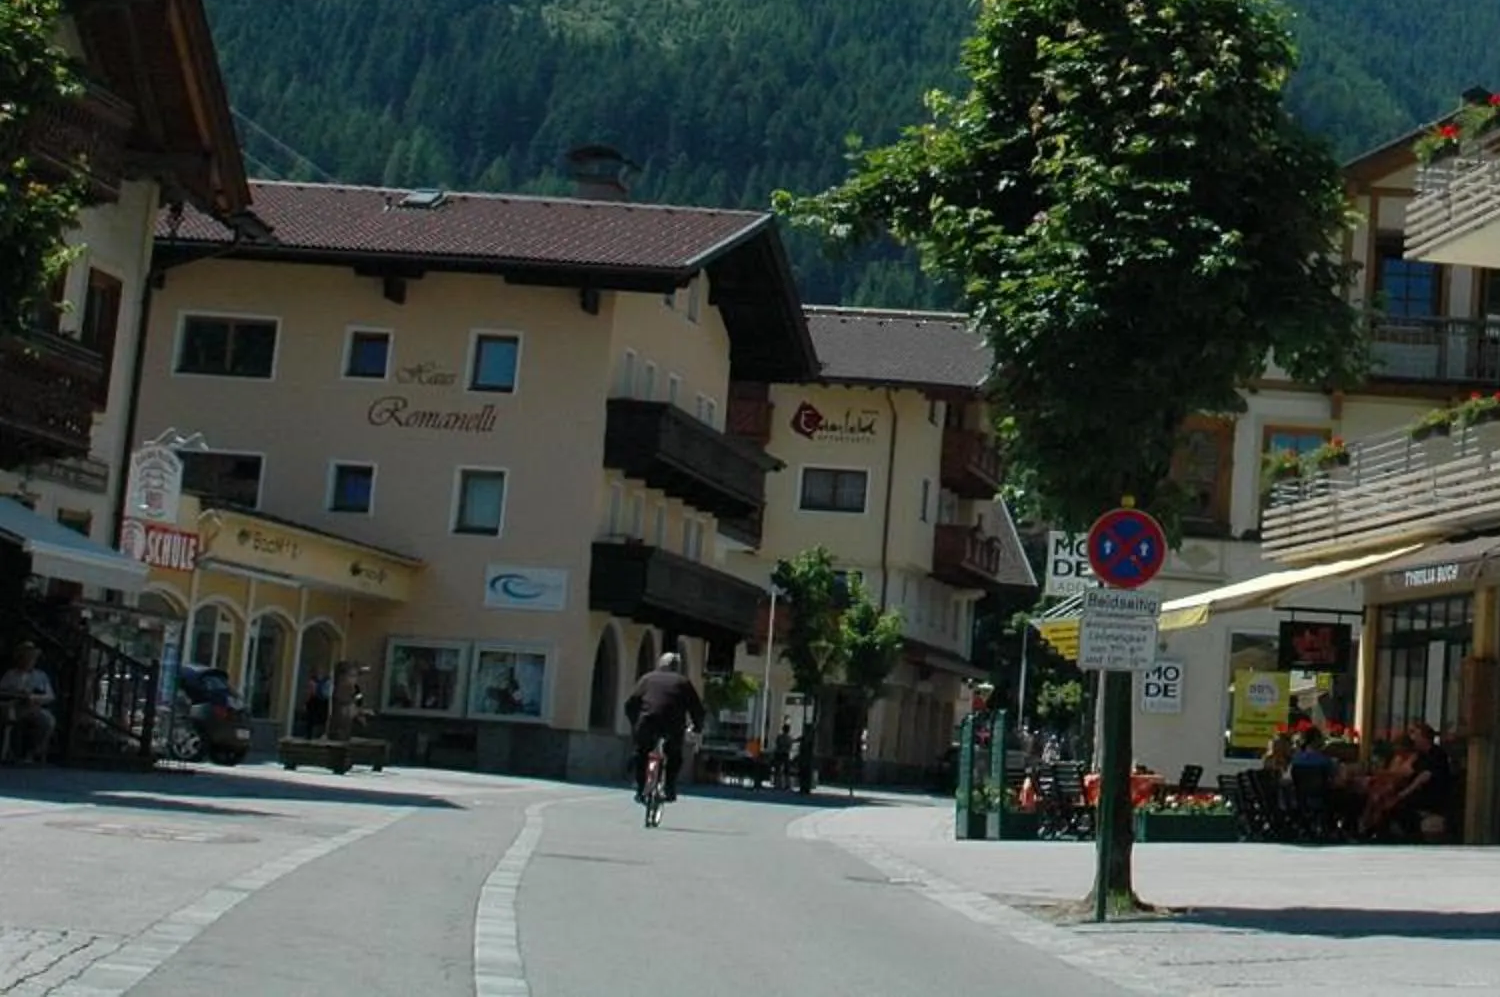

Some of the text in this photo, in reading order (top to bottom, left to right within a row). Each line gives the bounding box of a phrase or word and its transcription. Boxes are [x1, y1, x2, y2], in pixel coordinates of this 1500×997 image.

[368, 396, 497, 433] Romanelli
[1145, 666, 1180, 681] MO
[1145, 683, 1178, 698] DE
